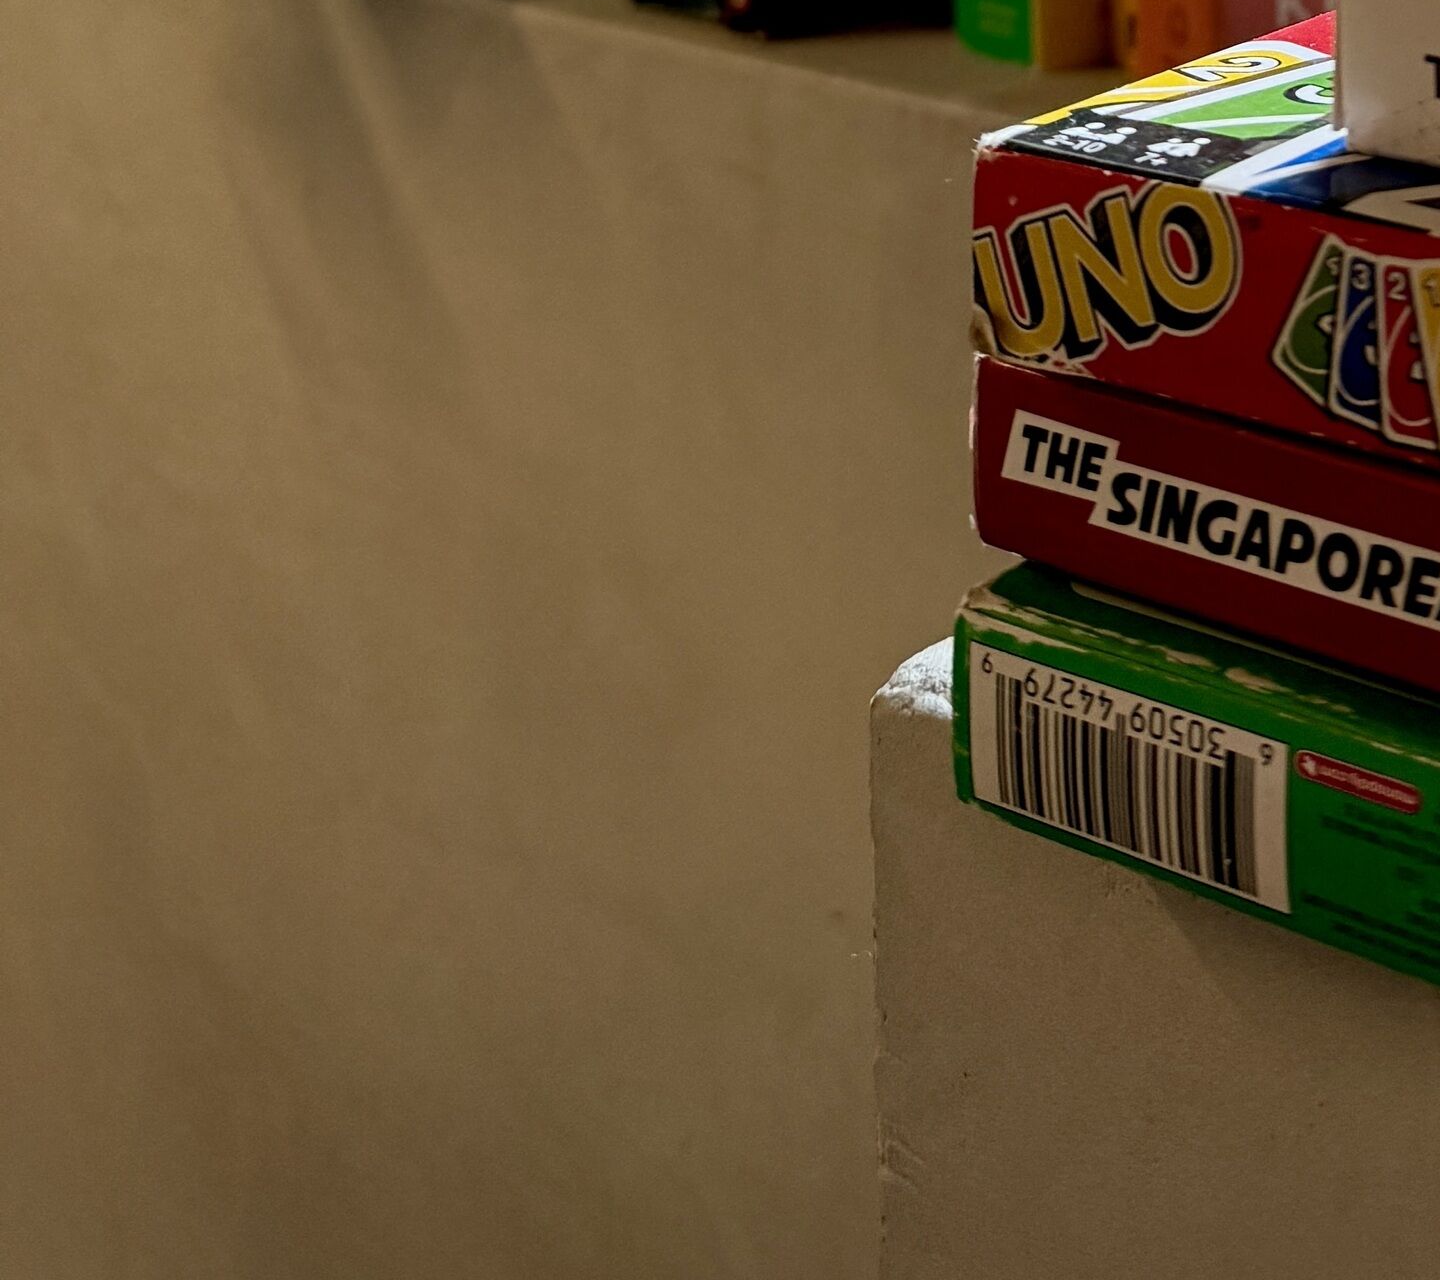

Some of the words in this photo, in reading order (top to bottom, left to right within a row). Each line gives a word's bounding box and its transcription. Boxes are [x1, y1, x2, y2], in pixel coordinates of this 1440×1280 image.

[973, 180, 1242, 360] UNO
[1350, 260, 1374, 291] 3
[1385, 270, 1407, 301] 2
[1020, 421, 1103, 493] THE
[1023, 667, 1114, 722] 44279
[1129, 702, 1227, 761] 30509
